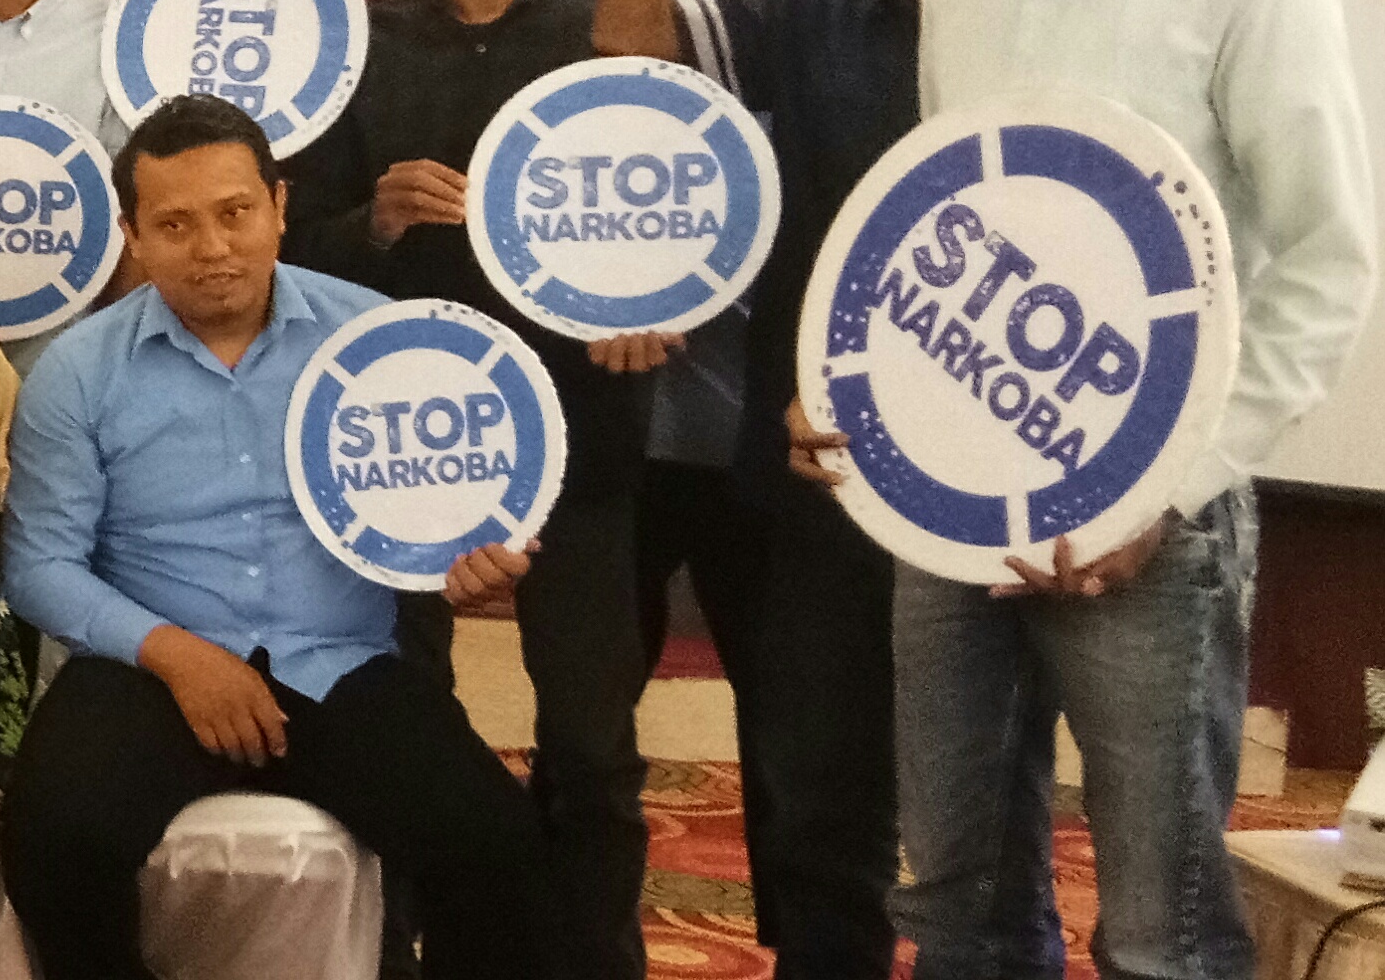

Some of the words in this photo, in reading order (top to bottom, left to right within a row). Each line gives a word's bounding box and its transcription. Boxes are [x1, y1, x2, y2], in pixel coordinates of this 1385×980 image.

[526, 153, 718, 208] STOP
[523, 209, 722, 241] NARKOBA
[912, 203, 1140, 402] STOP
[876, 270, 1092, 474] NARKOBA
[337, 394, 503, 456] STOP
[335, 450, 514, 491] NARKOBA
